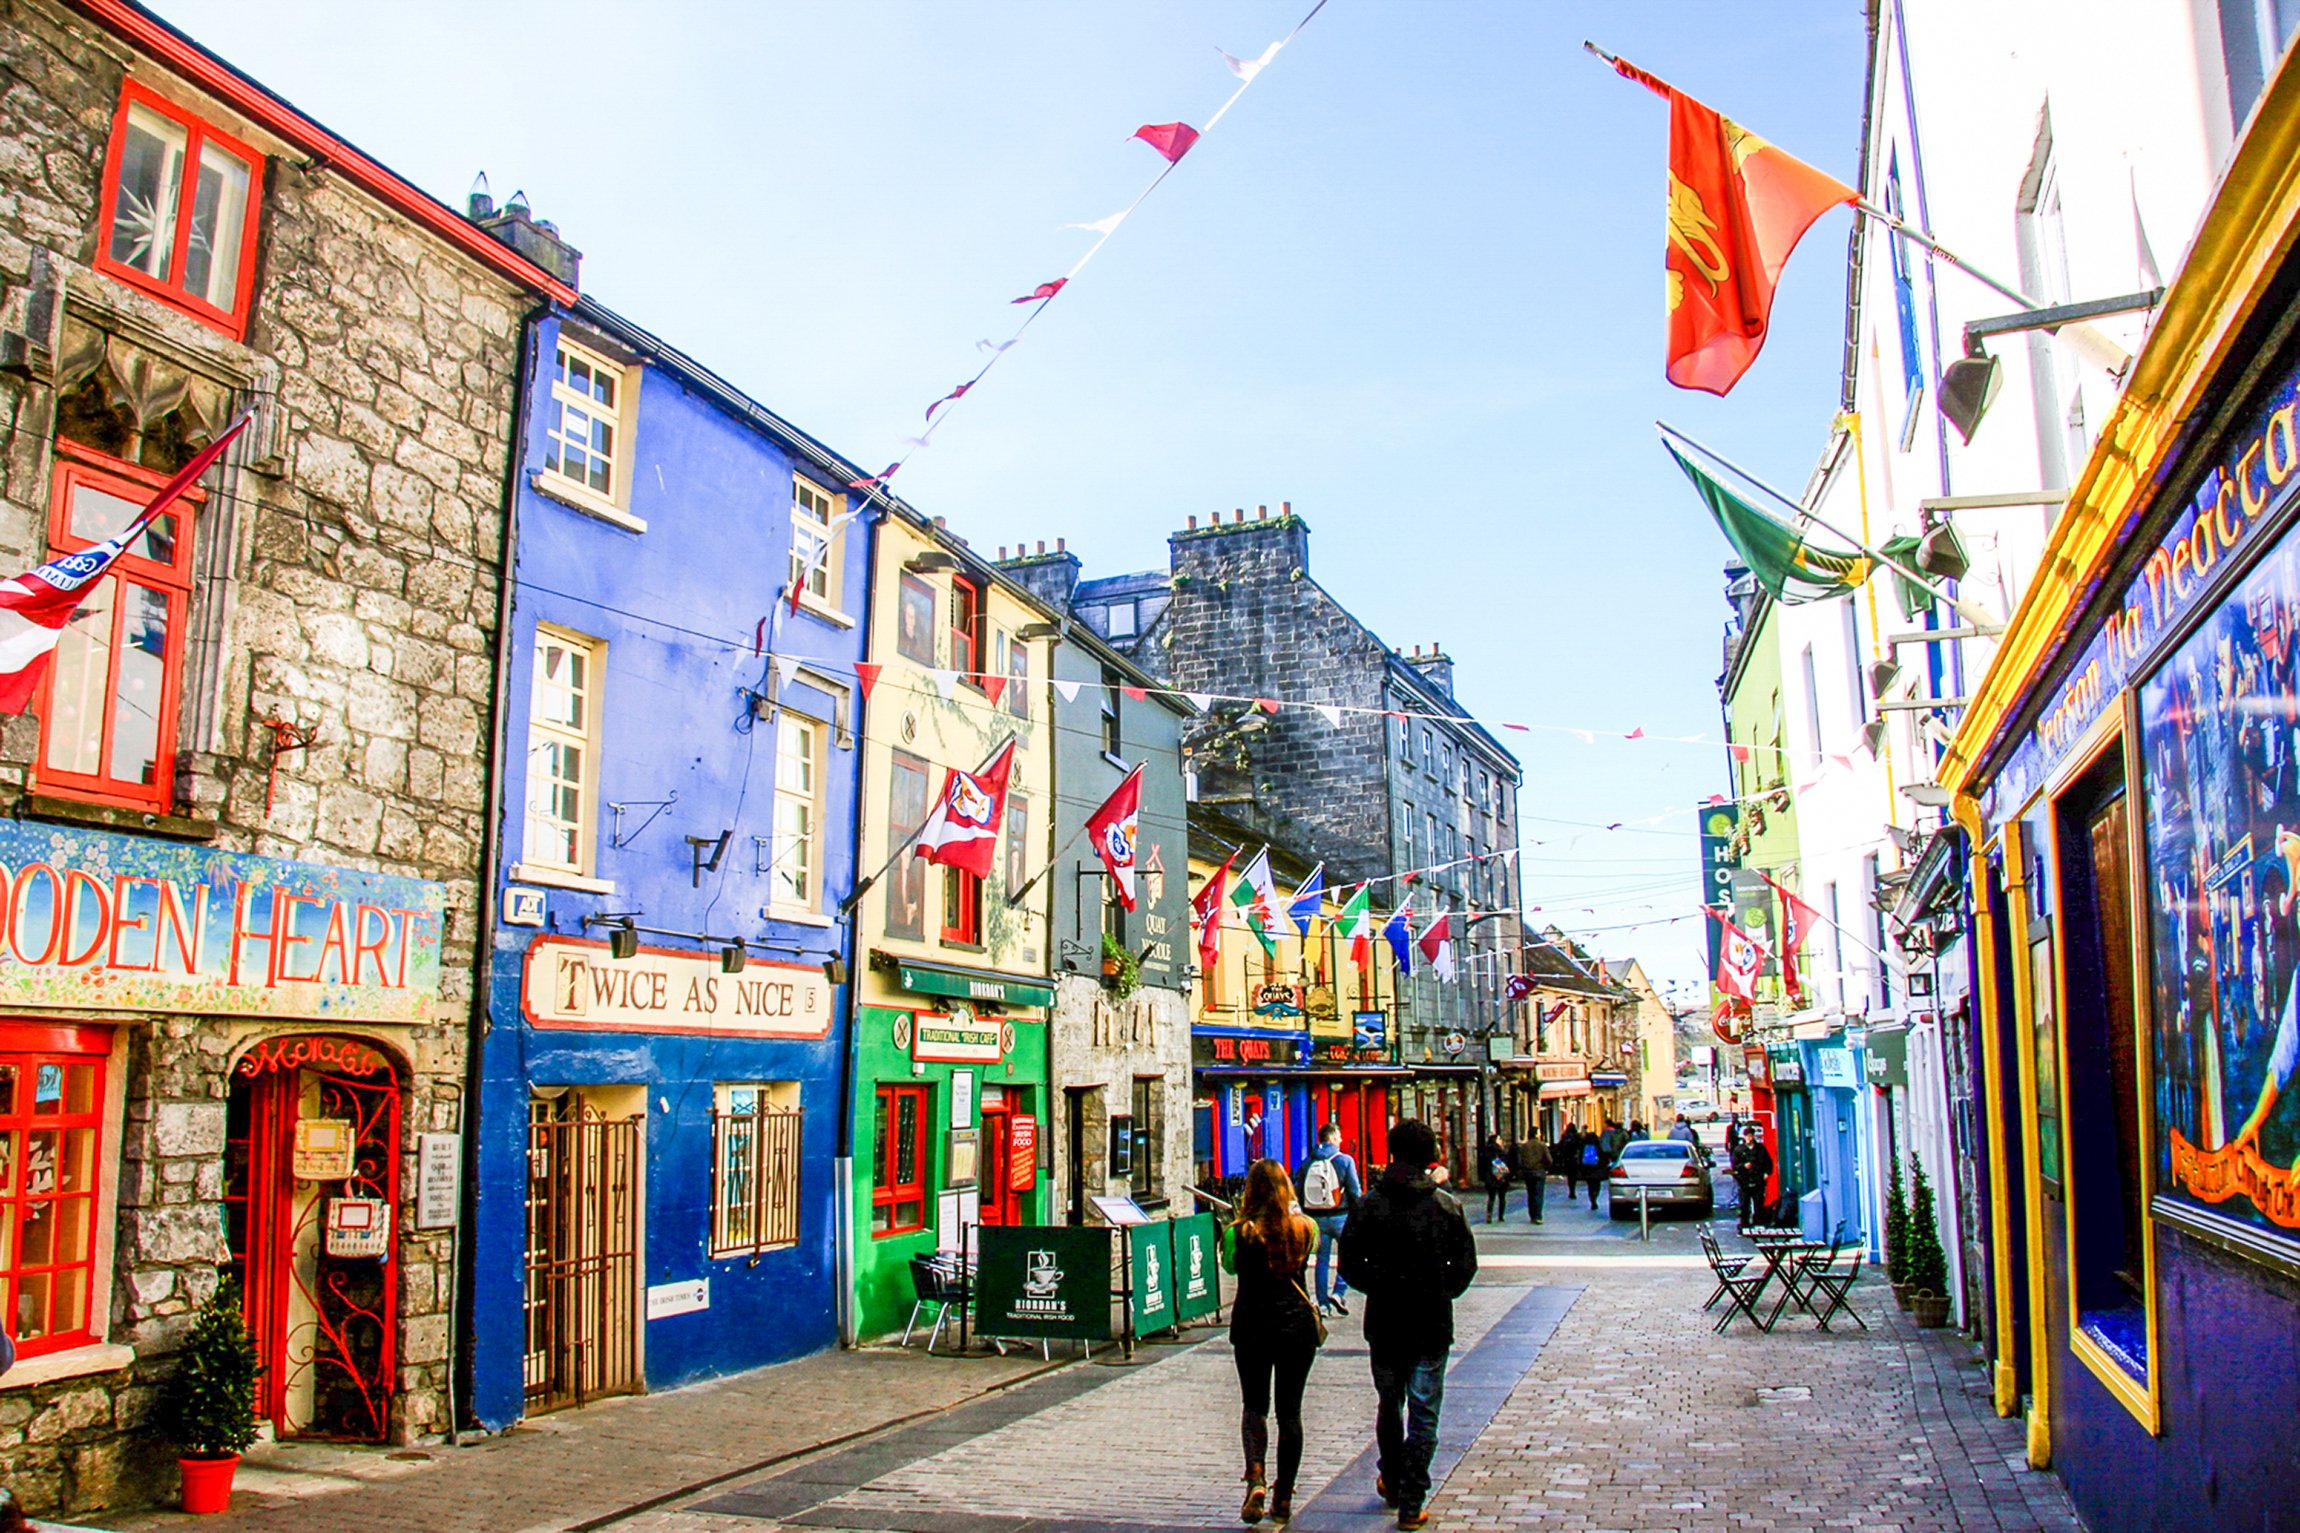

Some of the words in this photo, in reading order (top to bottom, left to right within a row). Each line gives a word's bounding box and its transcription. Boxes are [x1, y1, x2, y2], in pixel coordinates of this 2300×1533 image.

[0, 860, 209, 975] ODEN
[228, 879, 429, 989] HEART
[558, 955, 669, 1011] TWICE
[683, 975, 719, 1014] AS
[735, 979, 794, 1018] NICE
[806, 991, 816, 1010] 5
[1213, 1038, 1236, 1060] THE
[1239, 1040, 1272, 1066] QUAYS
[1015, 1299, 1067, 1311] RIORDAN'S
[1006, 1312, 1042, 1320] TRADITIONAL
[1043, 1313, 1057, 1321] IRISH
[1058, 1314, 1075, 1322] FOOD
